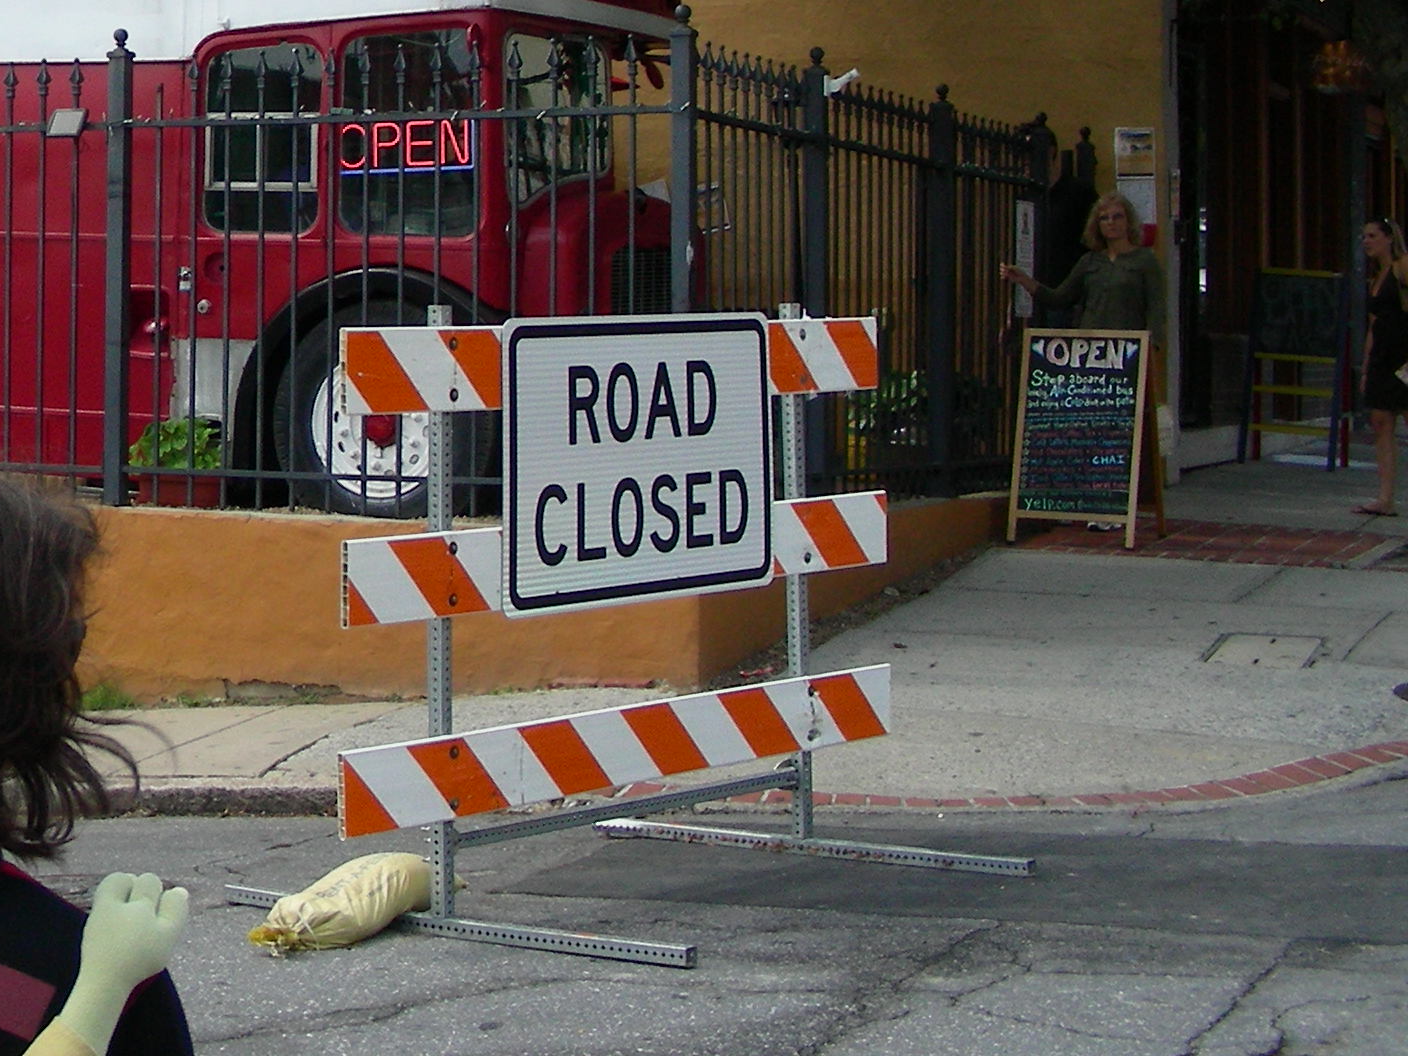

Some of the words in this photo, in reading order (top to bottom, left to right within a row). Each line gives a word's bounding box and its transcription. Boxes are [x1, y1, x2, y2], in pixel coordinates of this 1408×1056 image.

[341, 119, 470, 169] OPEN
[1046, 338, 1126, 370] OPEN
[1031, 369, 1065, 386] Step
[1069, 373, 1106, 385] aboard
[1109, 376, 1129, 385] our
[1116, 384, 1133, 396] bus
[568, 360, 716, 445] ROAD
[1092, 455, 1125, 465] CHAI
[535, 469, 748, 566] CLOSED
